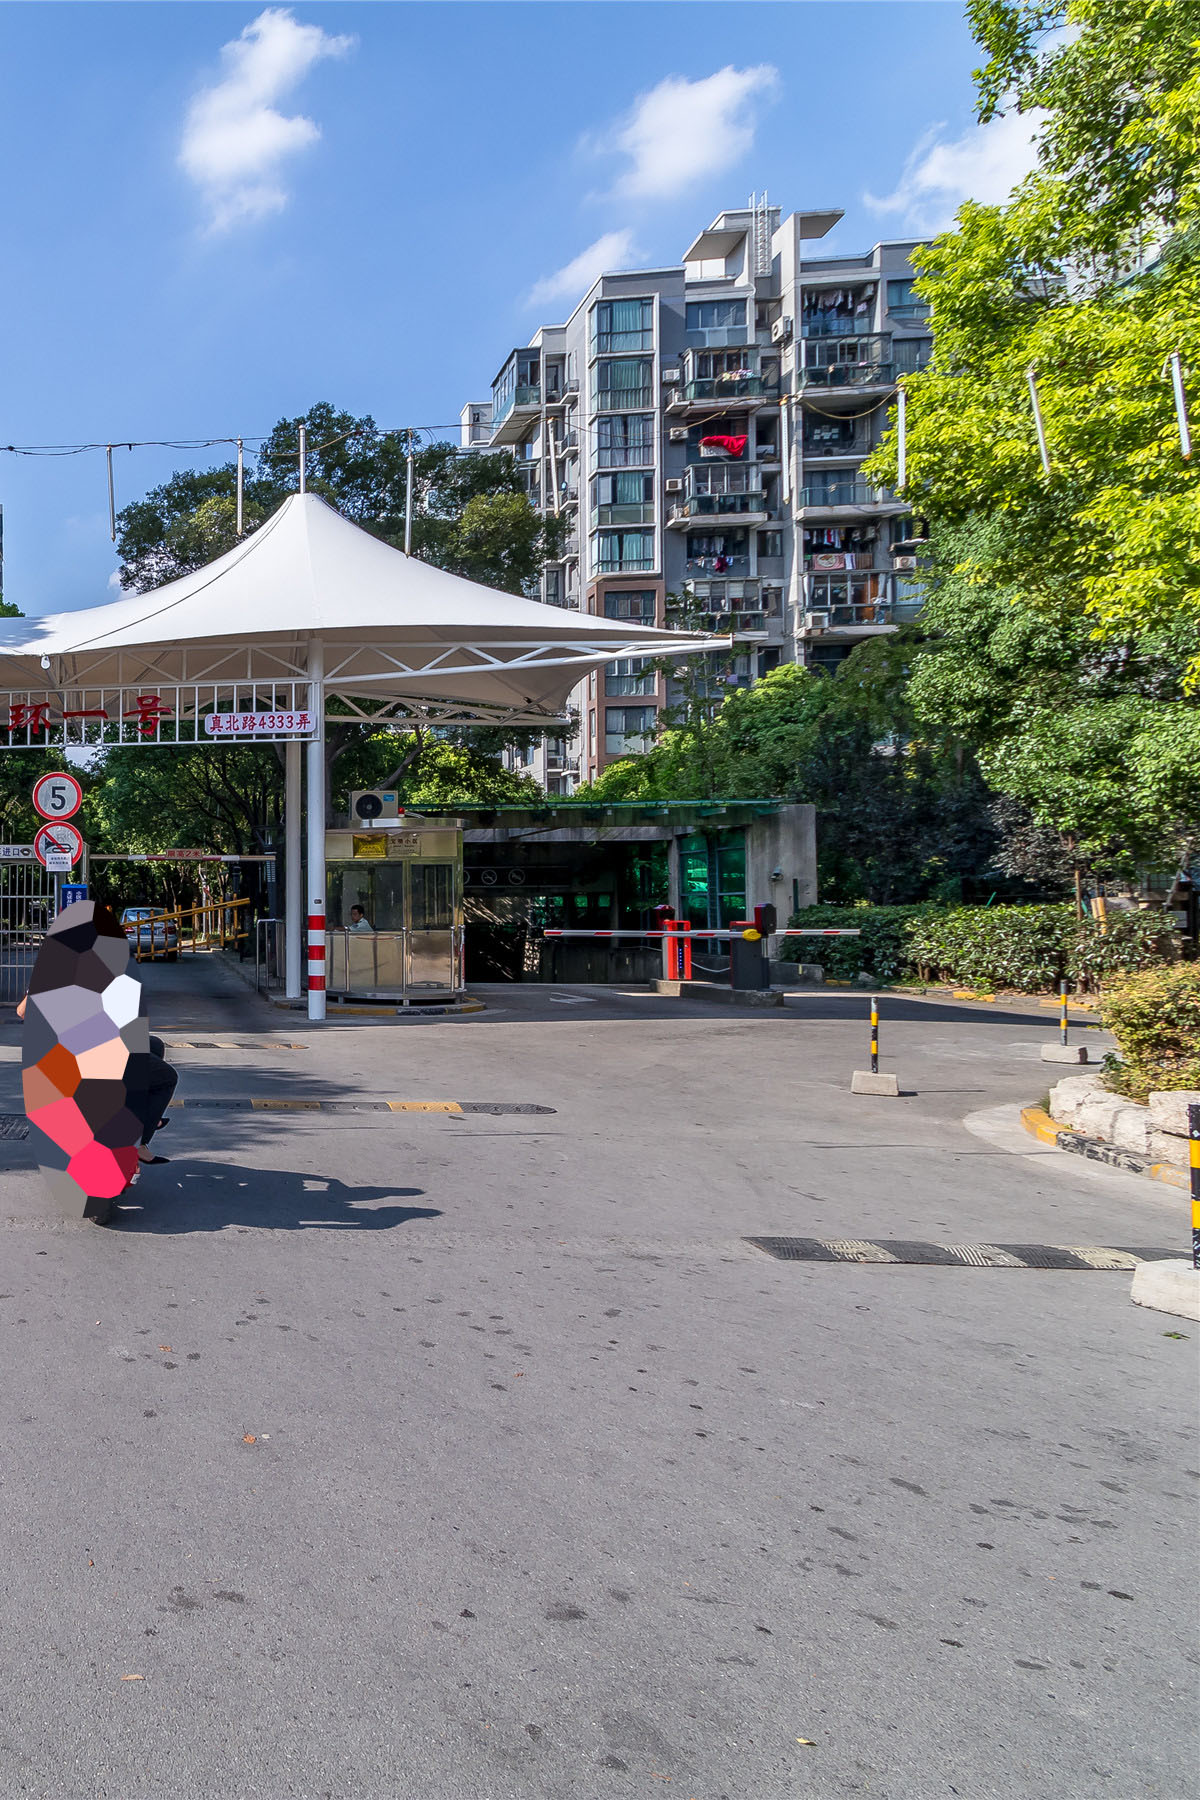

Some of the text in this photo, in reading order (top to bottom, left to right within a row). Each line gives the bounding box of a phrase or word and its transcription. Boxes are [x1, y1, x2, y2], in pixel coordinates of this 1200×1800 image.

[209, 713, 311, 733] 真北路4333弄
[51, 786, 66, 810] 5
